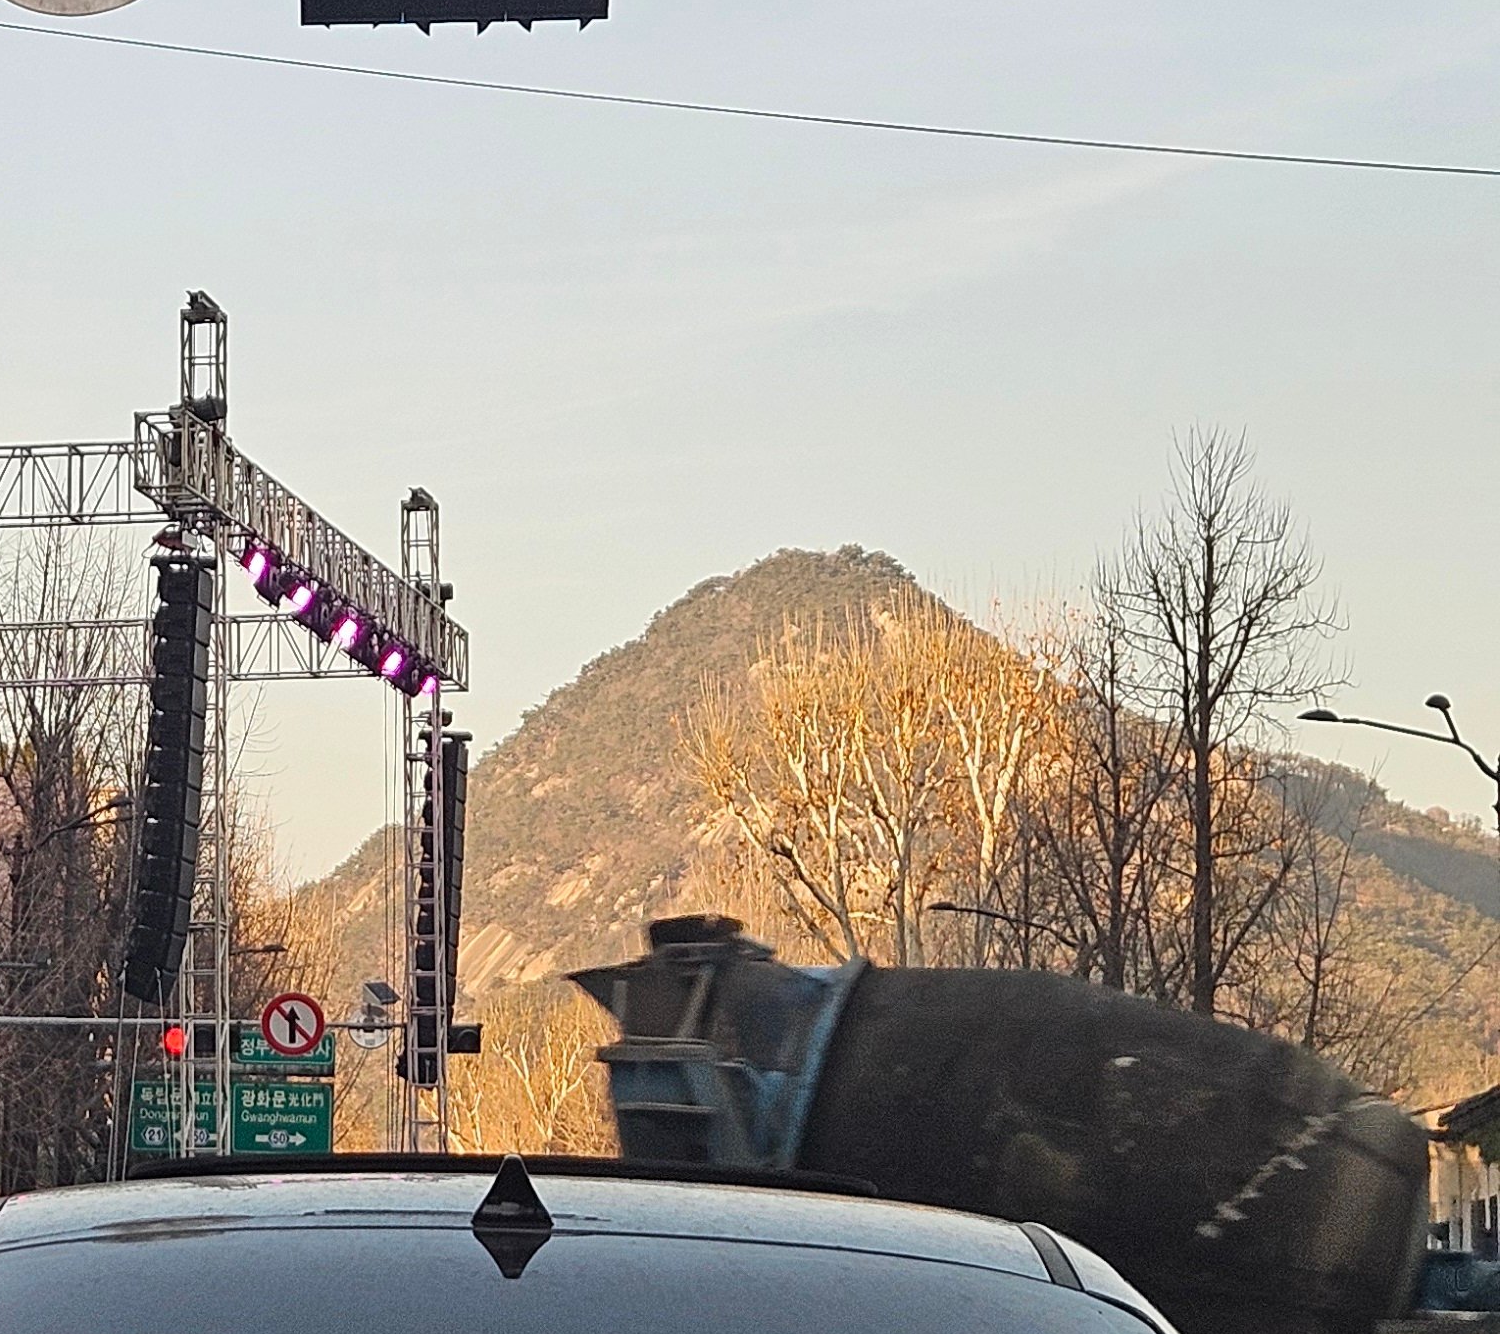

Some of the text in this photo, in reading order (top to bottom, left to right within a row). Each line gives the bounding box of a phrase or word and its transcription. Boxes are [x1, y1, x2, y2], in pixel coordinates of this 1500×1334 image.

[240, 1038, 331, 1058] 정부사
[241, 1089, 324, 1108] 광화문 光化門
[240, 1109, 317, 1125] Gwanghwamun
[147, 1129, 162, 1142] 21
[271, 1132, 286, 1145] 50
